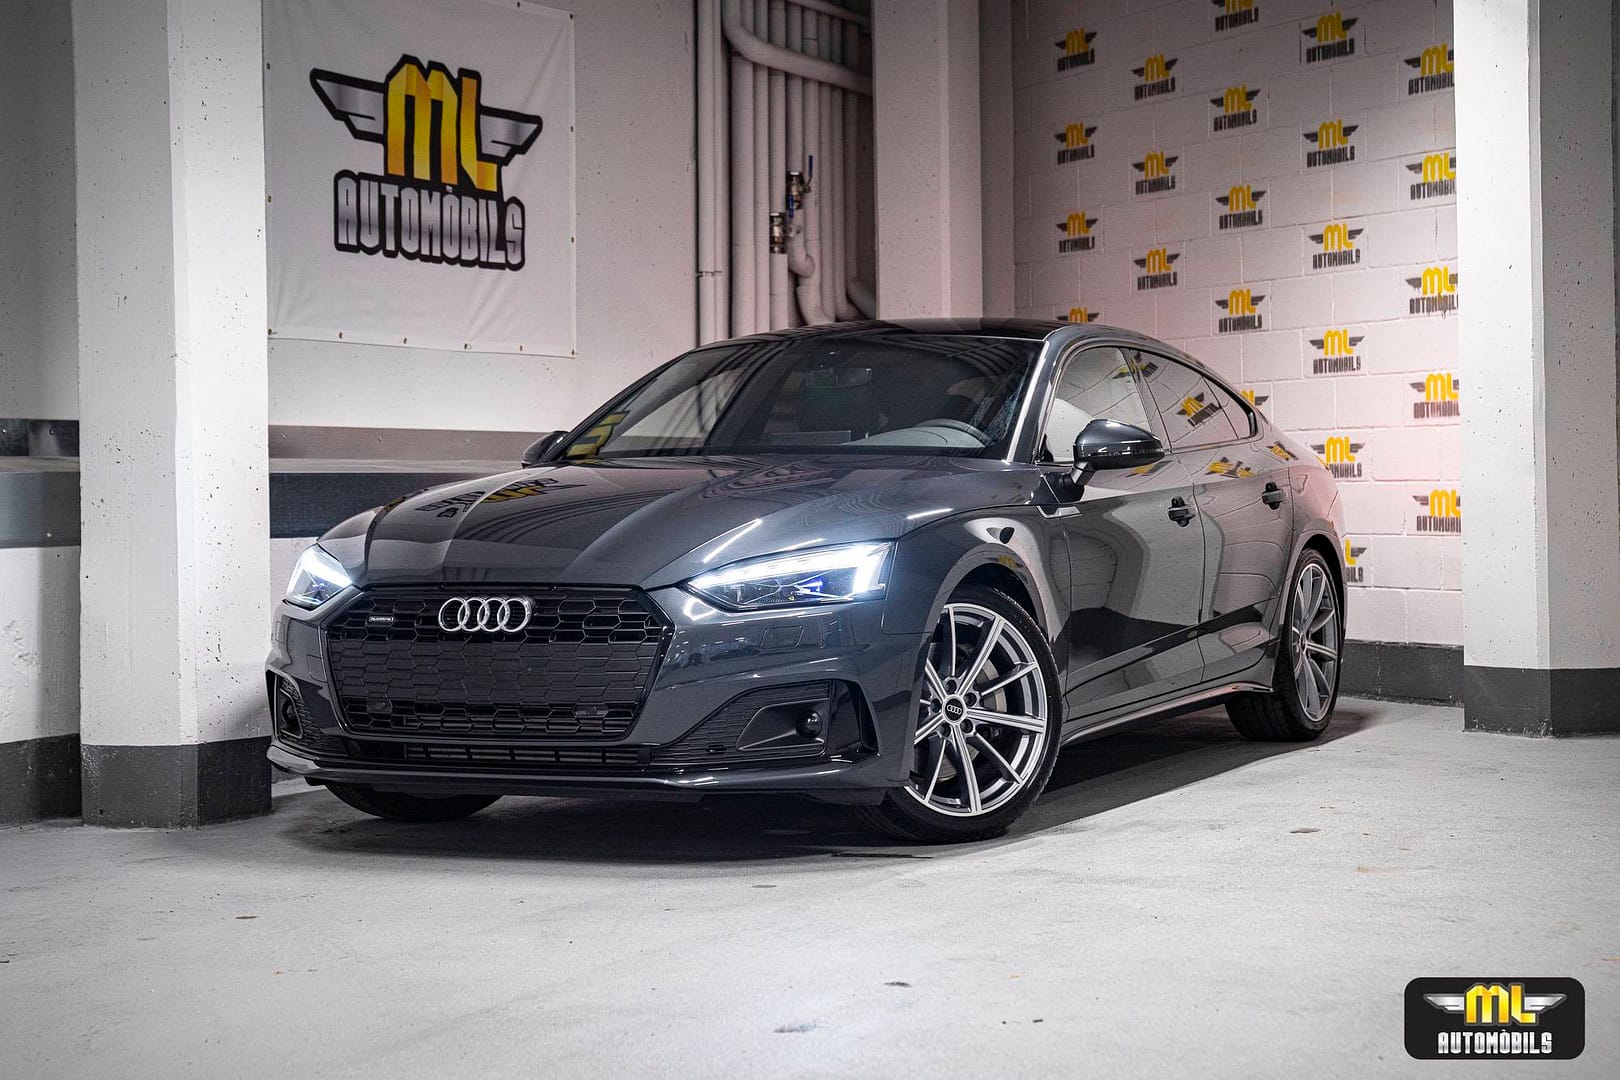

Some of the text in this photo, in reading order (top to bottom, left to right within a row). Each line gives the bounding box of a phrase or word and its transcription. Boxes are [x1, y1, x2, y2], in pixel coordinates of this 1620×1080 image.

[1316, 12, 1347, 42] ML
[1065, 28, 1089, 55] ML
[1144, 54, 1170, 82] ML
[1408, 71, 1455, 95] AUTOMOBIL
[1223, 85, 1252, 113] ML
[385, 59, 501, 192] ML
[1065, 122, 1089, 148] ML
[1317, 119, 1348, 149] ML
[1144, 151, 1170, 178] ML
[1422, 152, 1456, 184] ML
[1229, 185, 1257, 212] ML
[1066, 211, 1090, 236] ML
[1322, 223, 1353, 252] ML
[1146, 247, 1172, 273] ML
[1422, 266, 1455, 296] ML
[1228, 288, 1257, 316] ML
[1323, 329, 1353, 356] ML
[1425, 373, 1459, 401] ML
[1413, 400, 1461, 419] AUTOMOBIL
[1325, 436, 1355, 465] ML
[1430, 489, 1461, 518] ML
